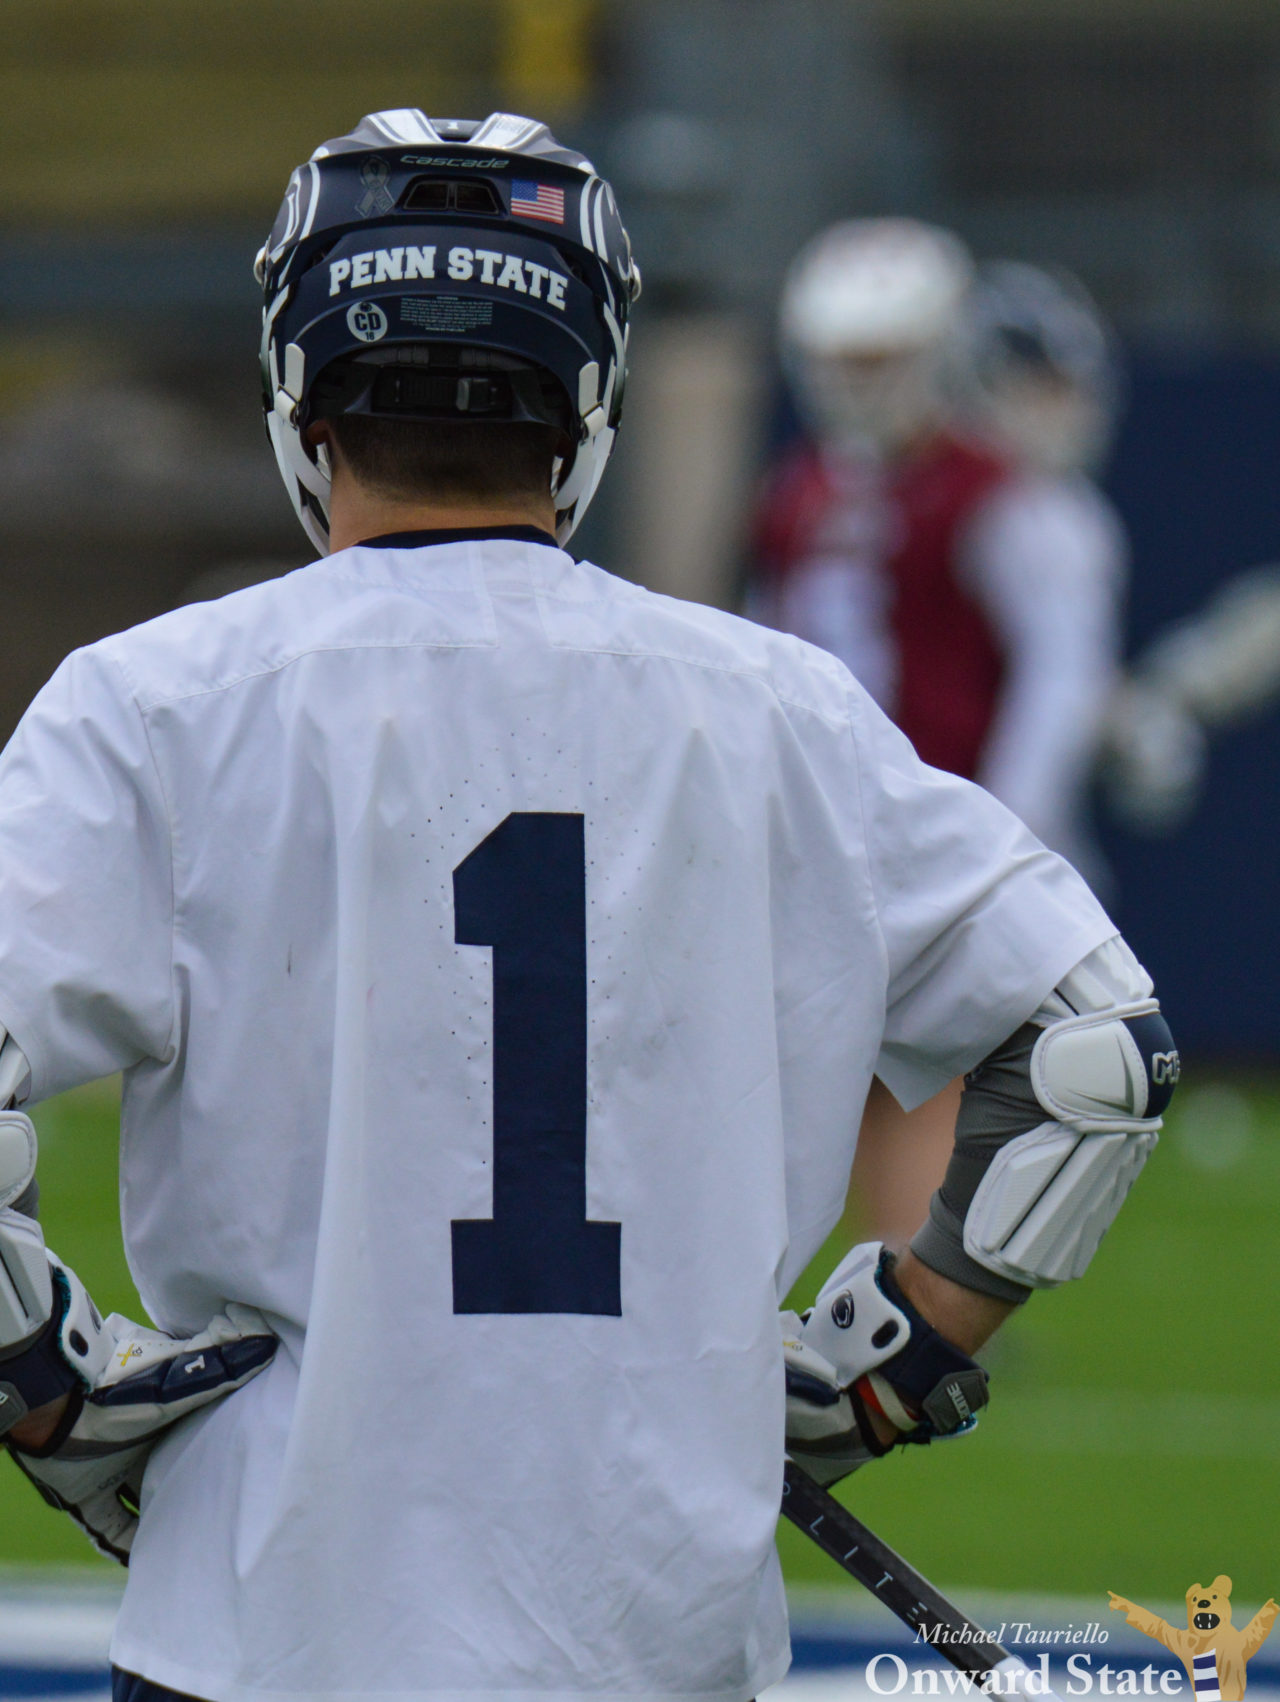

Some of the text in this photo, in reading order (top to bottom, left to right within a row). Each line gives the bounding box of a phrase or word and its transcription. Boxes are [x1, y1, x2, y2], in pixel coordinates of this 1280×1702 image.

[400, 154, 511, 169] cascade
[329, 245, 569, 311] PENN STATE
[354, 312, 381, 331] CD
[451, 812, 622, 1316] 1
[184, 1354, 206, 1374] 1
